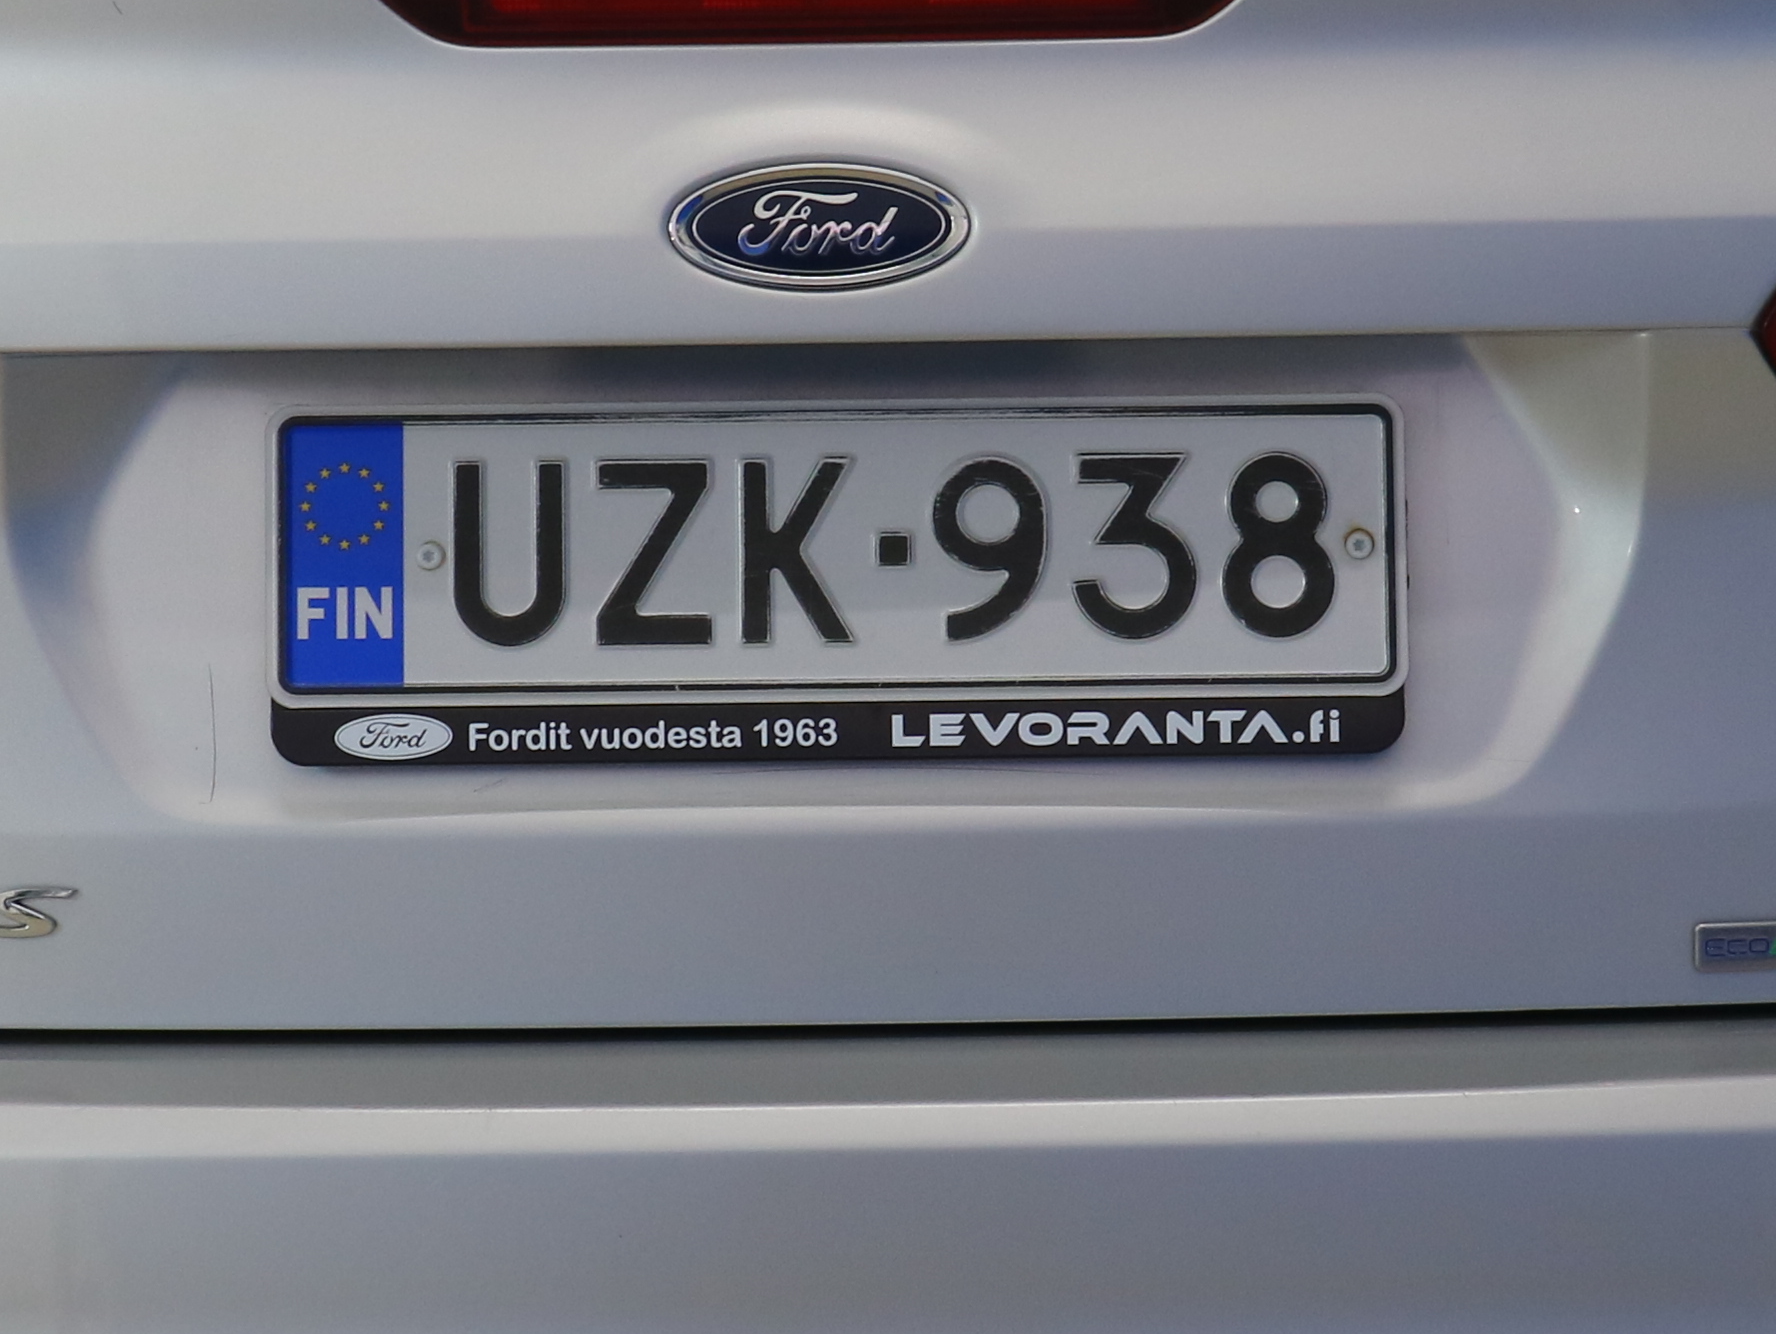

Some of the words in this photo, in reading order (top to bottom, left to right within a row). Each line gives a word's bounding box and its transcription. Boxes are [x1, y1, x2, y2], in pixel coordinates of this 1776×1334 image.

[737, 189, 900, 256] Ford
[296, 586, 394, 640] FIN
[358, 723, 427, 749] Ford
[467, 720, 572, 752] Fordit
[579, 720, 742, 751] vuodesta
[752, 718, 839, 748] 1963
[890, 708, 1342, 748] LEVORANTA.fi
